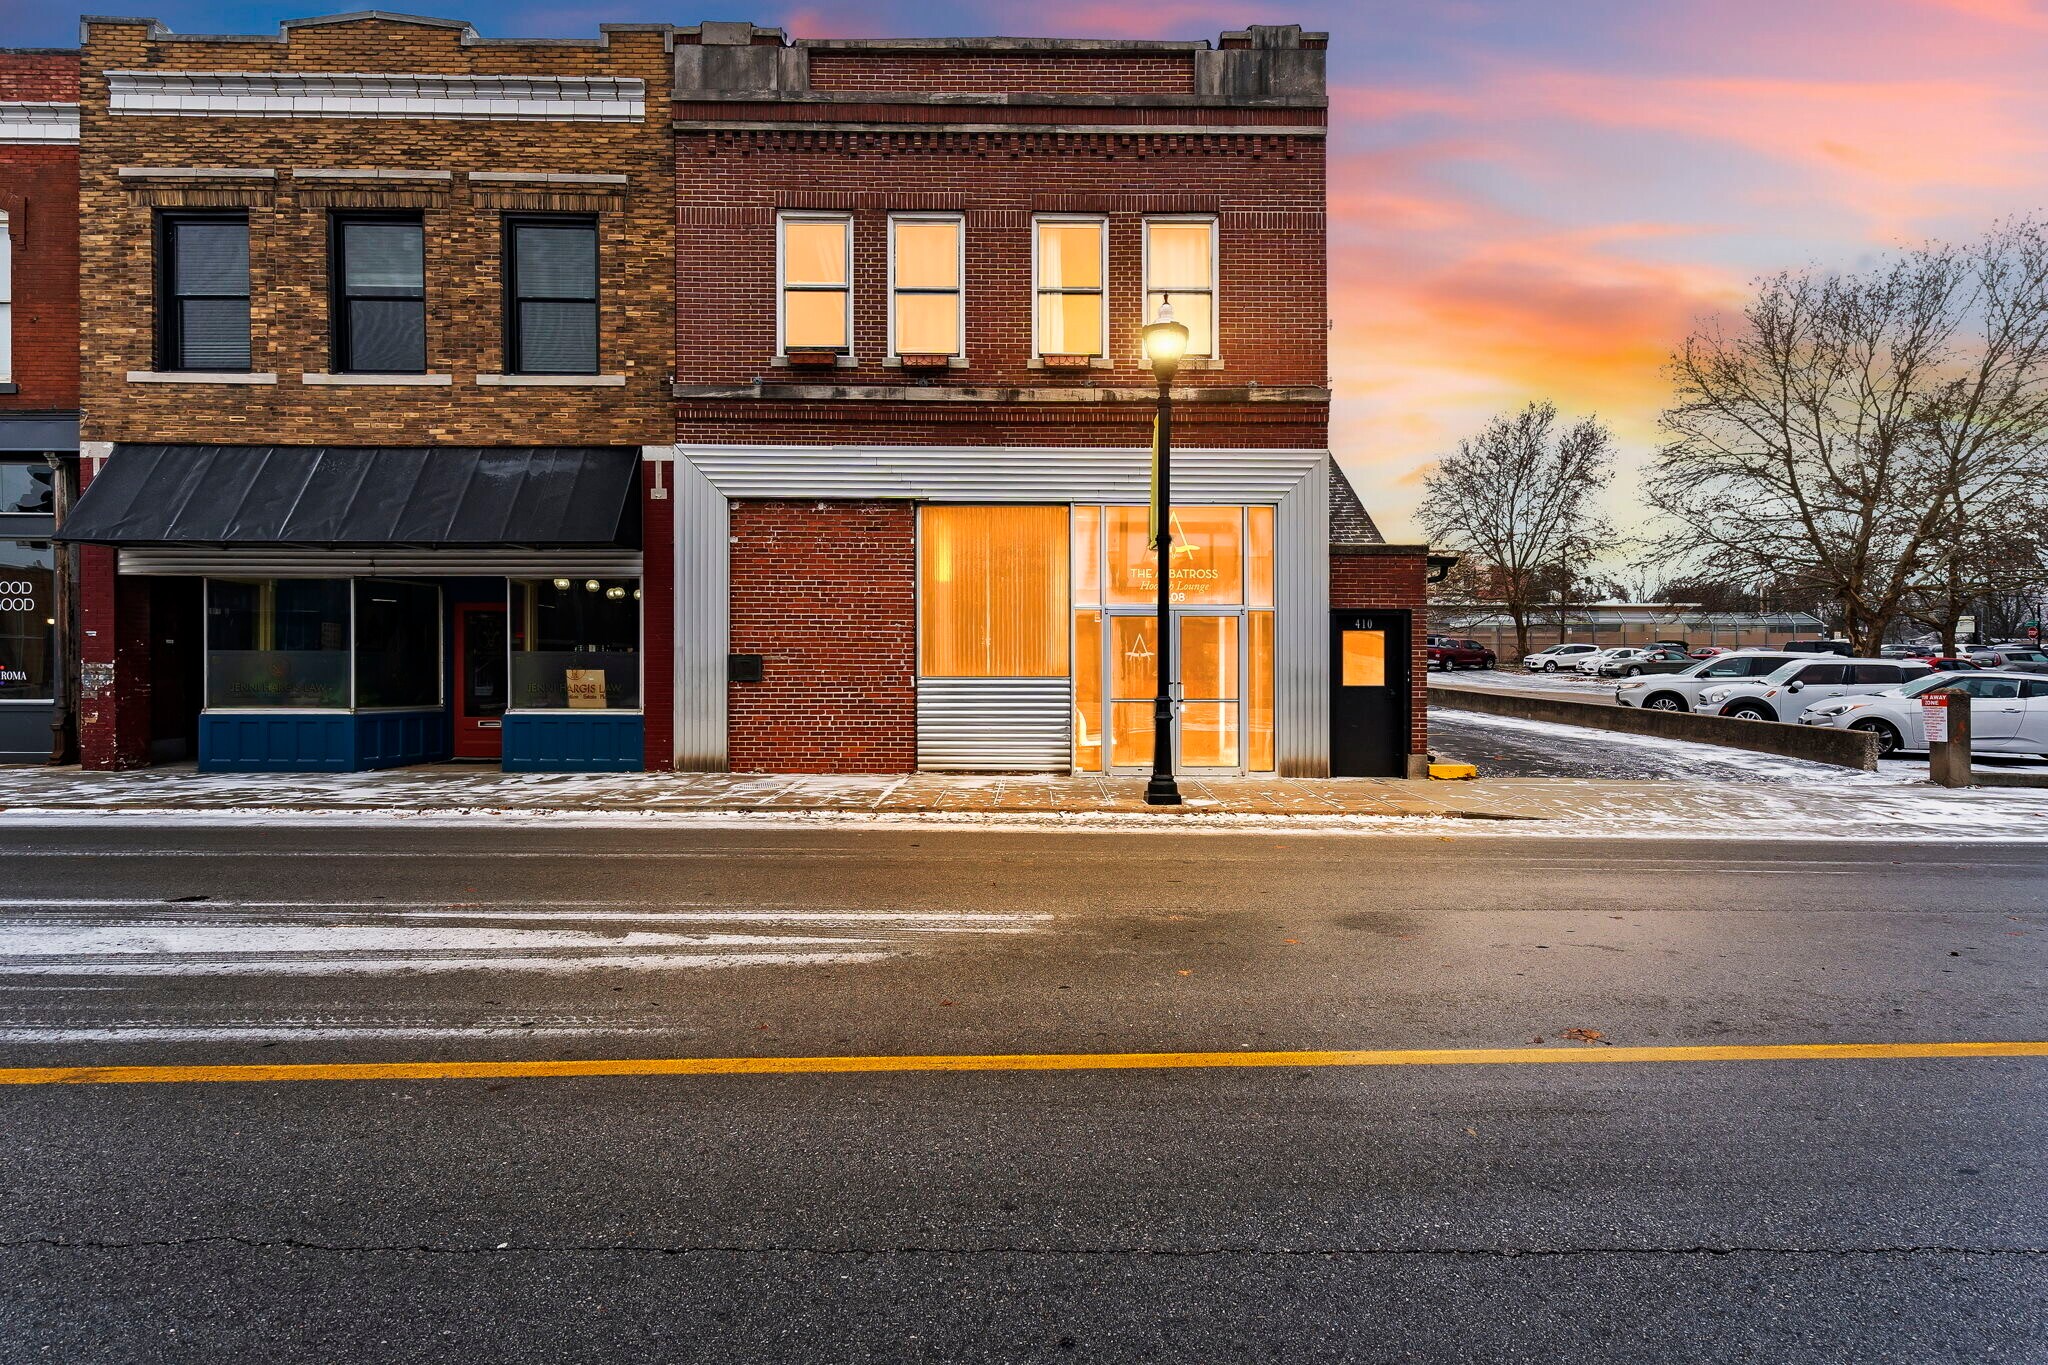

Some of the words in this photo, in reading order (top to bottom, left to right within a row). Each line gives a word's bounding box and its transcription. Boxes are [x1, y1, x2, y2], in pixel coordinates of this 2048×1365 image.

[1130, 568, 1153, 579] THE
[1155, 568, 1219, 579] BATROSS
[1140, 580, 1175, 591] Hooh
[1177, 581, 1210, 593] Lounge
[1168, 592, 1186, 602] 08
[0, 597, 35, 611] OOD
[1355, 618, 1373, 629] 410
[1, 671, 27, 681] ROMA
